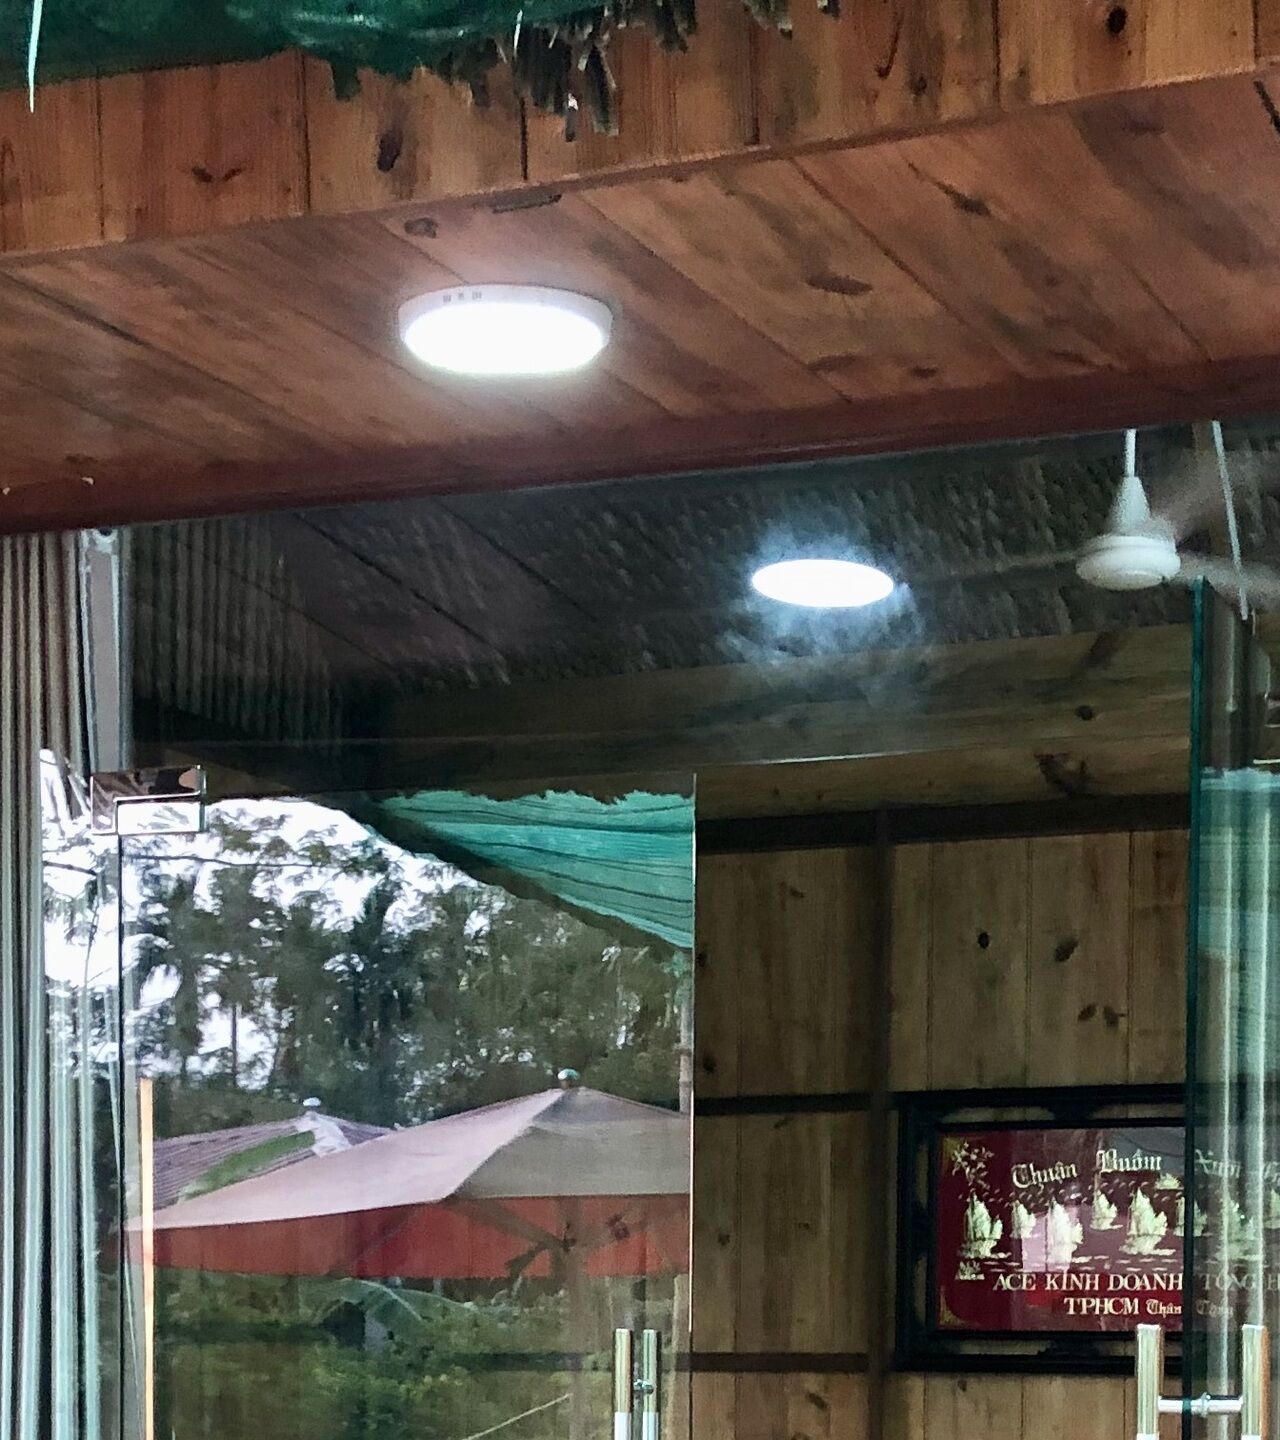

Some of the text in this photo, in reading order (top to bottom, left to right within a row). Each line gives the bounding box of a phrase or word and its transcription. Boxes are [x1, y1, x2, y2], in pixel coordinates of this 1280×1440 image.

[992, 1273, 1036, 1291] ACE
[1044, 1272, 1099, 1291] KINH
[1107, 1273, 1183, 1291] DOANH
[1063, 1297, 1140, 1316] TPHCM
